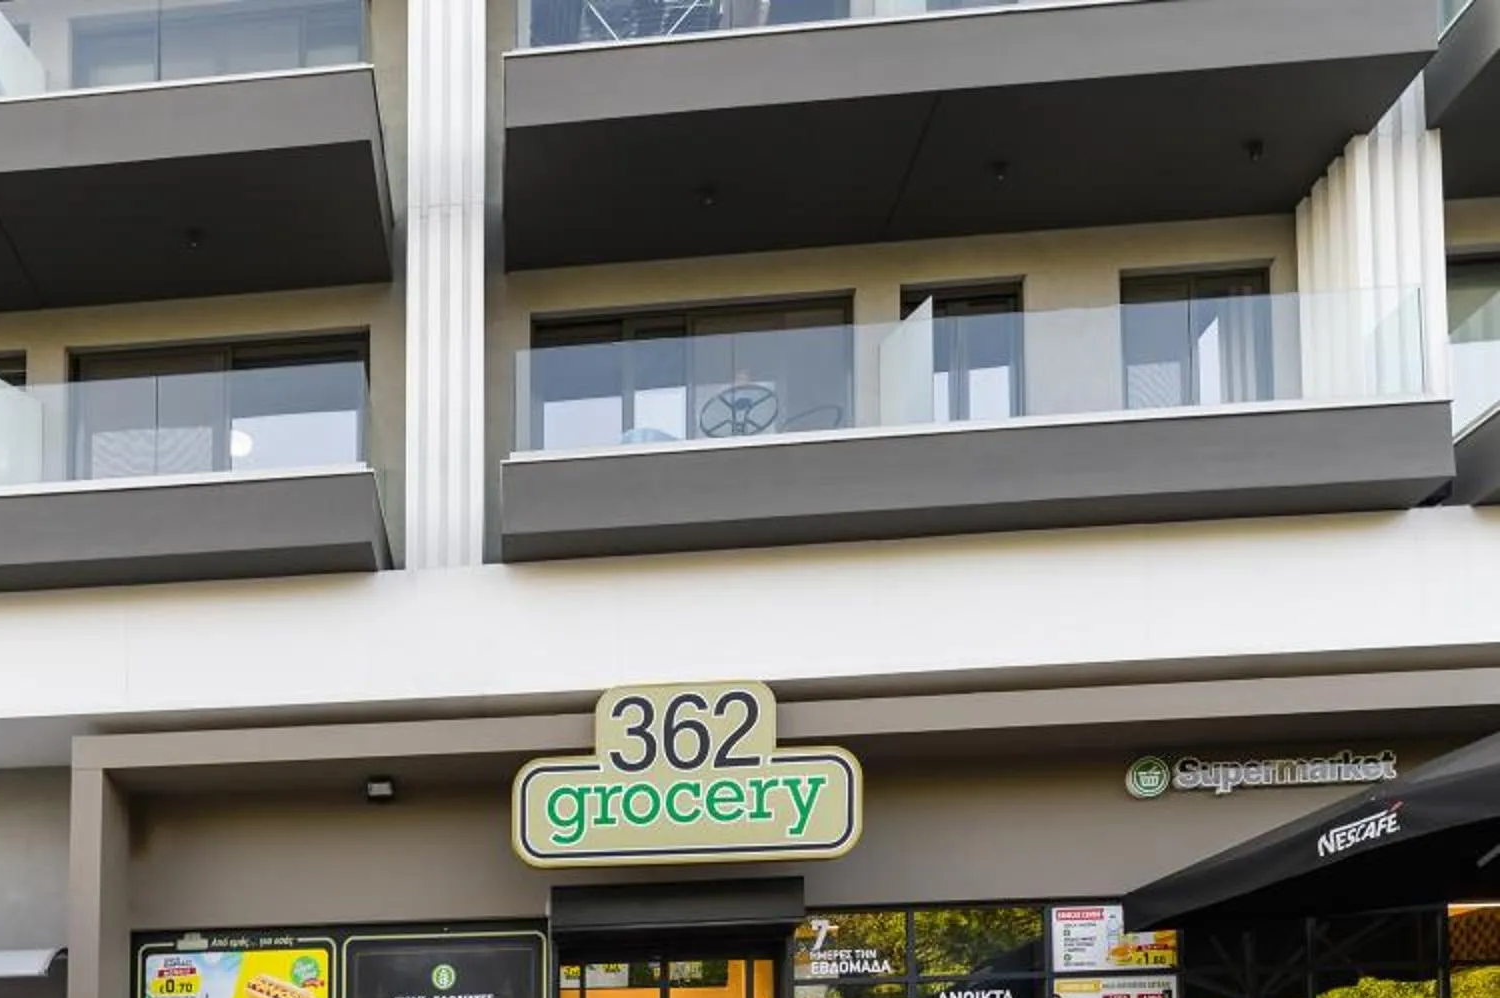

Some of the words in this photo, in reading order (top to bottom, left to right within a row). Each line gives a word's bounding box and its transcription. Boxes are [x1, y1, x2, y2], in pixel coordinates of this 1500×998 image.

[609, 691, 762, 772] 362
[1174, 750, 1397, 795] Supermarket
[546, 775, 827, 846] grocery
[811, 960, 891, 975] ΕΒΔΟΜΑΔΑ
